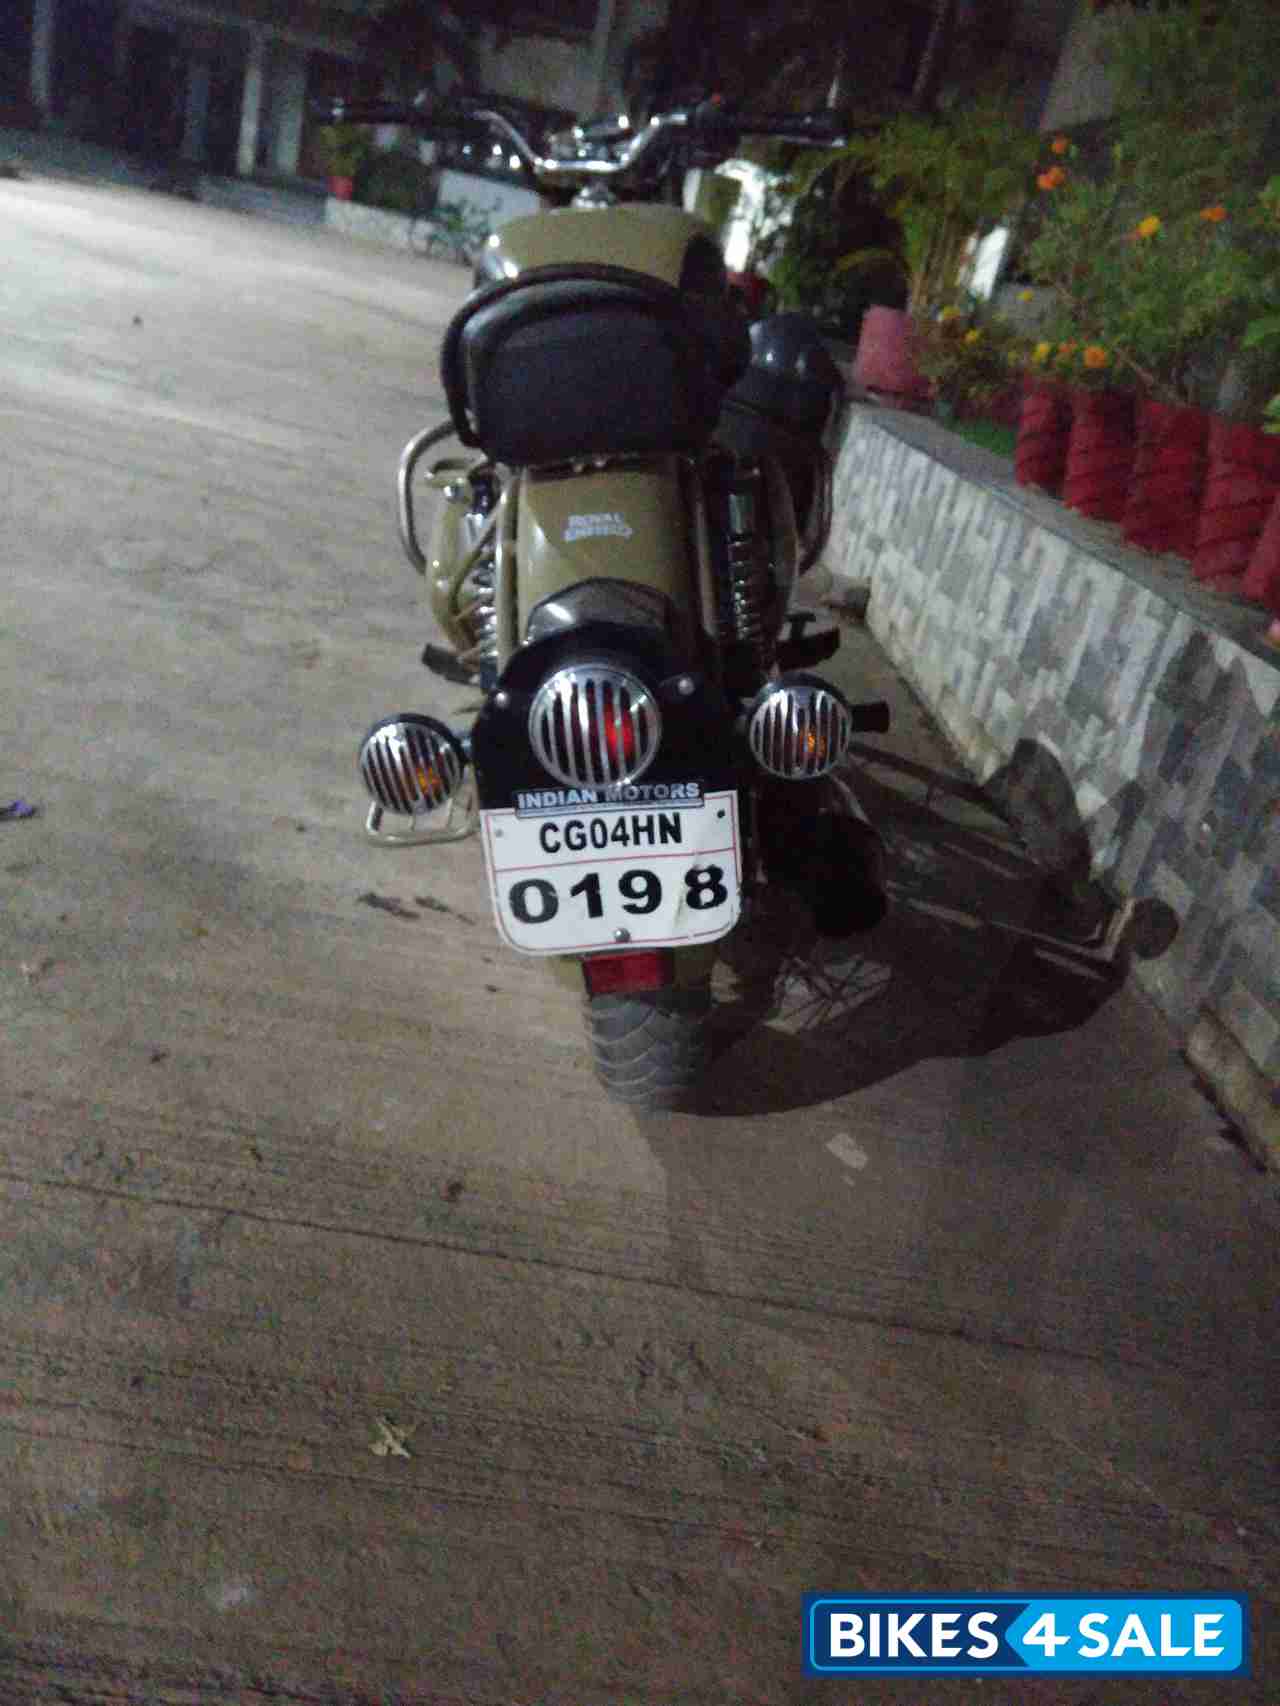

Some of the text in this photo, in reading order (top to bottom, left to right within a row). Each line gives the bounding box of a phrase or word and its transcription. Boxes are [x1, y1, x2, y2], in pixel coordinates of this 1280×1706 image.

[517, 783, 700, 809] INDIAN MOTORS
[539, 812, 682, 853] CG04HN
